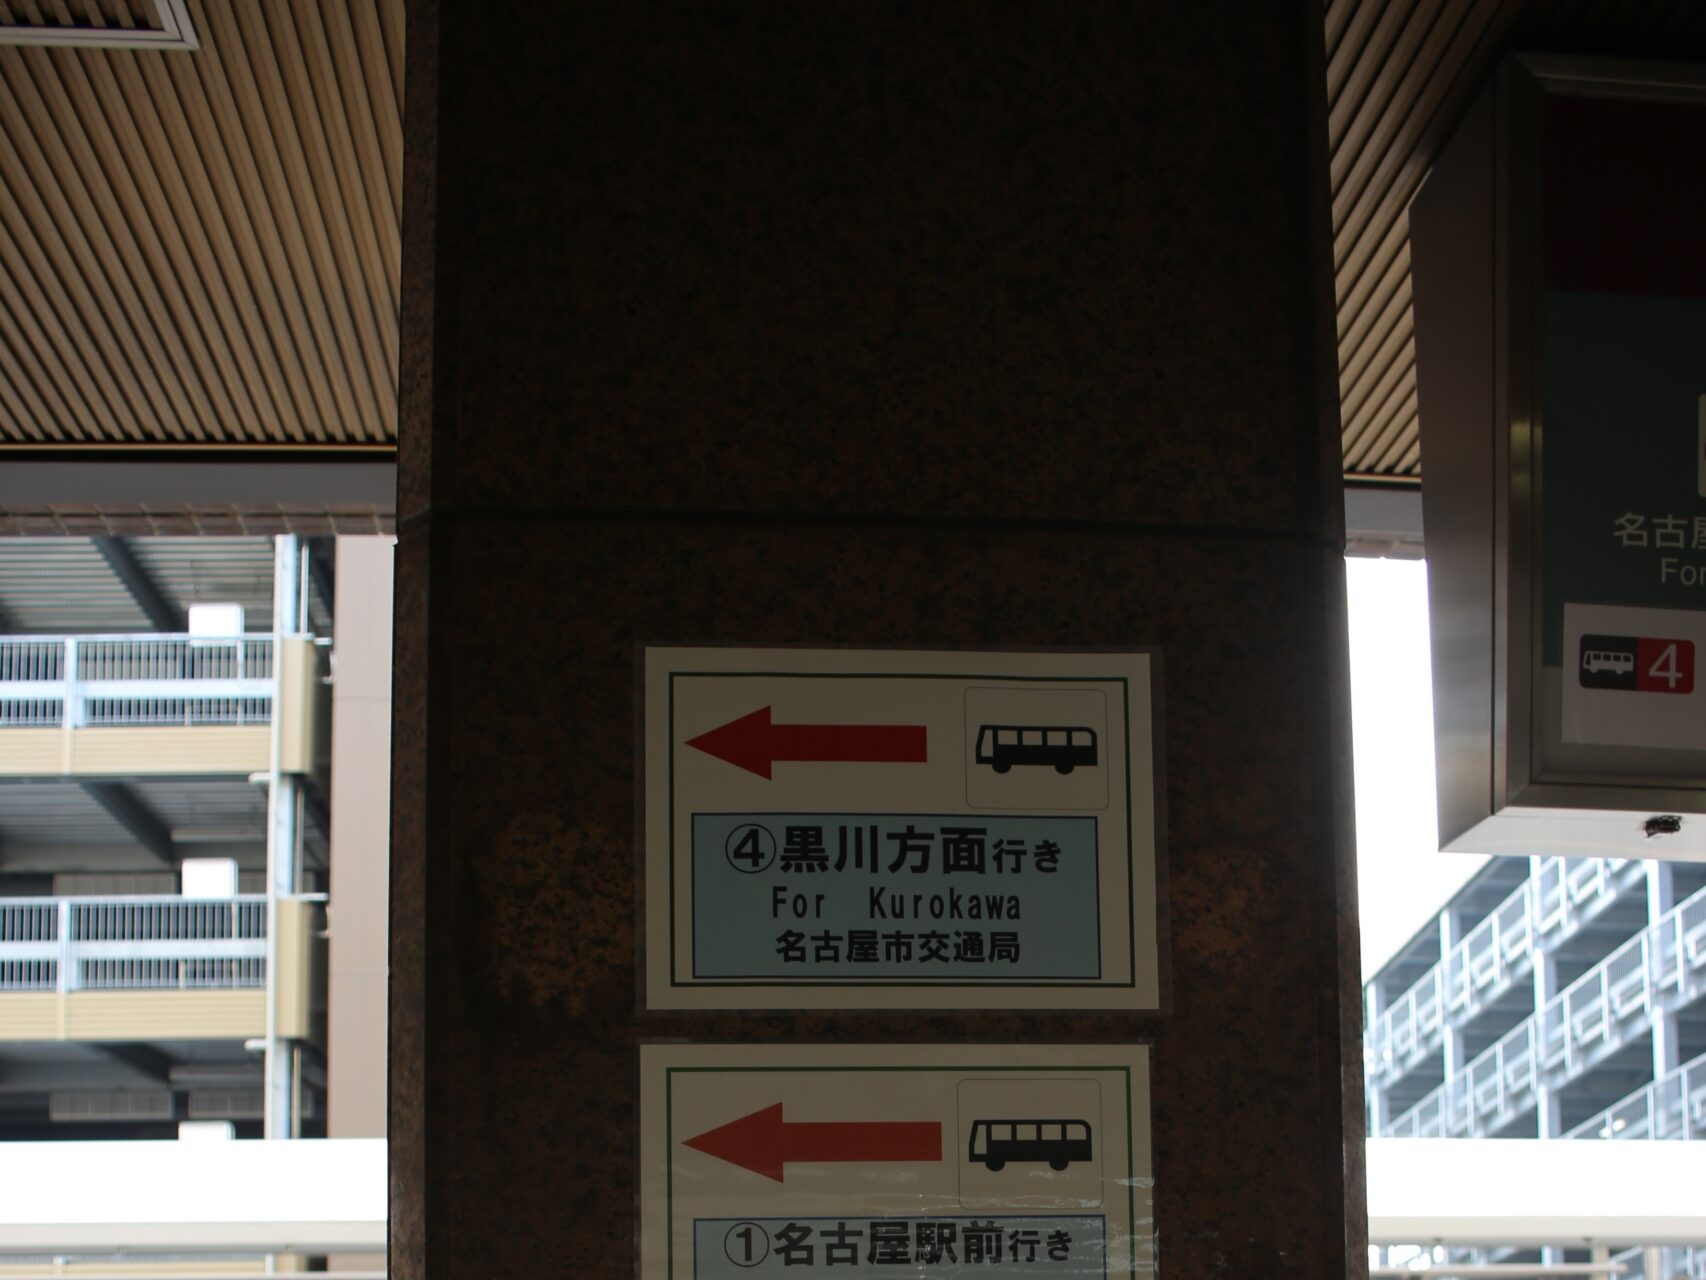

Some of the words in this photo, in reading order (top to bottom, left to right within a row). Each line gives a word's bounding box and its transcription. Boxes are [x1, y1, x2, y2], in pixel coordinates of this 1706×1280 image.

[1648, 643, 1683, 689] 4
[772, 886, 825, 919] For
[869, 886, 1021, 920] Kurokawa
[775, 929, 1020, 963] 名古屋市交通局
